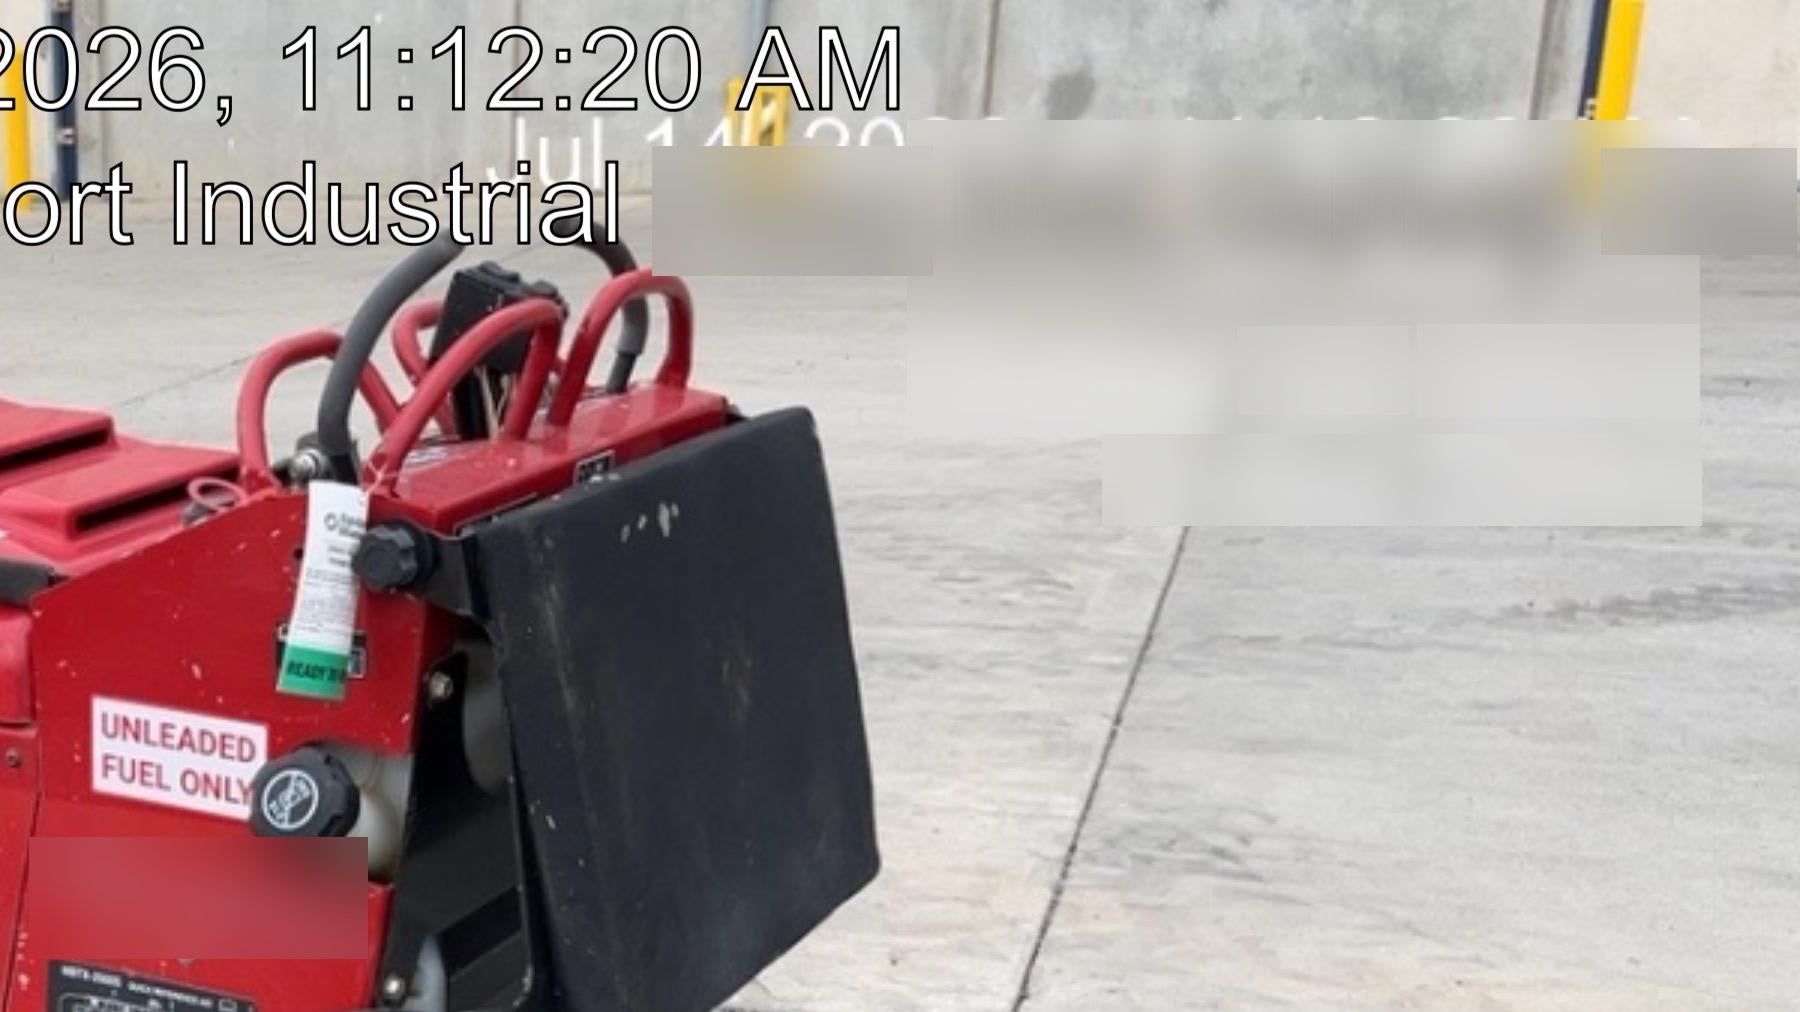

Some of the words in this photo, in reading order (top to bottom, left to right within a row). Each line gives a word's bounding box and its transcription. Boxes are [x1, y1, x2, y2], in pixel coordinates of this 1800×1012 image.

[101, 712, 256, 763] UNLEADED
[102, 753, 171, 791] FUEL
[180, 769, 253, 806] ONLY
